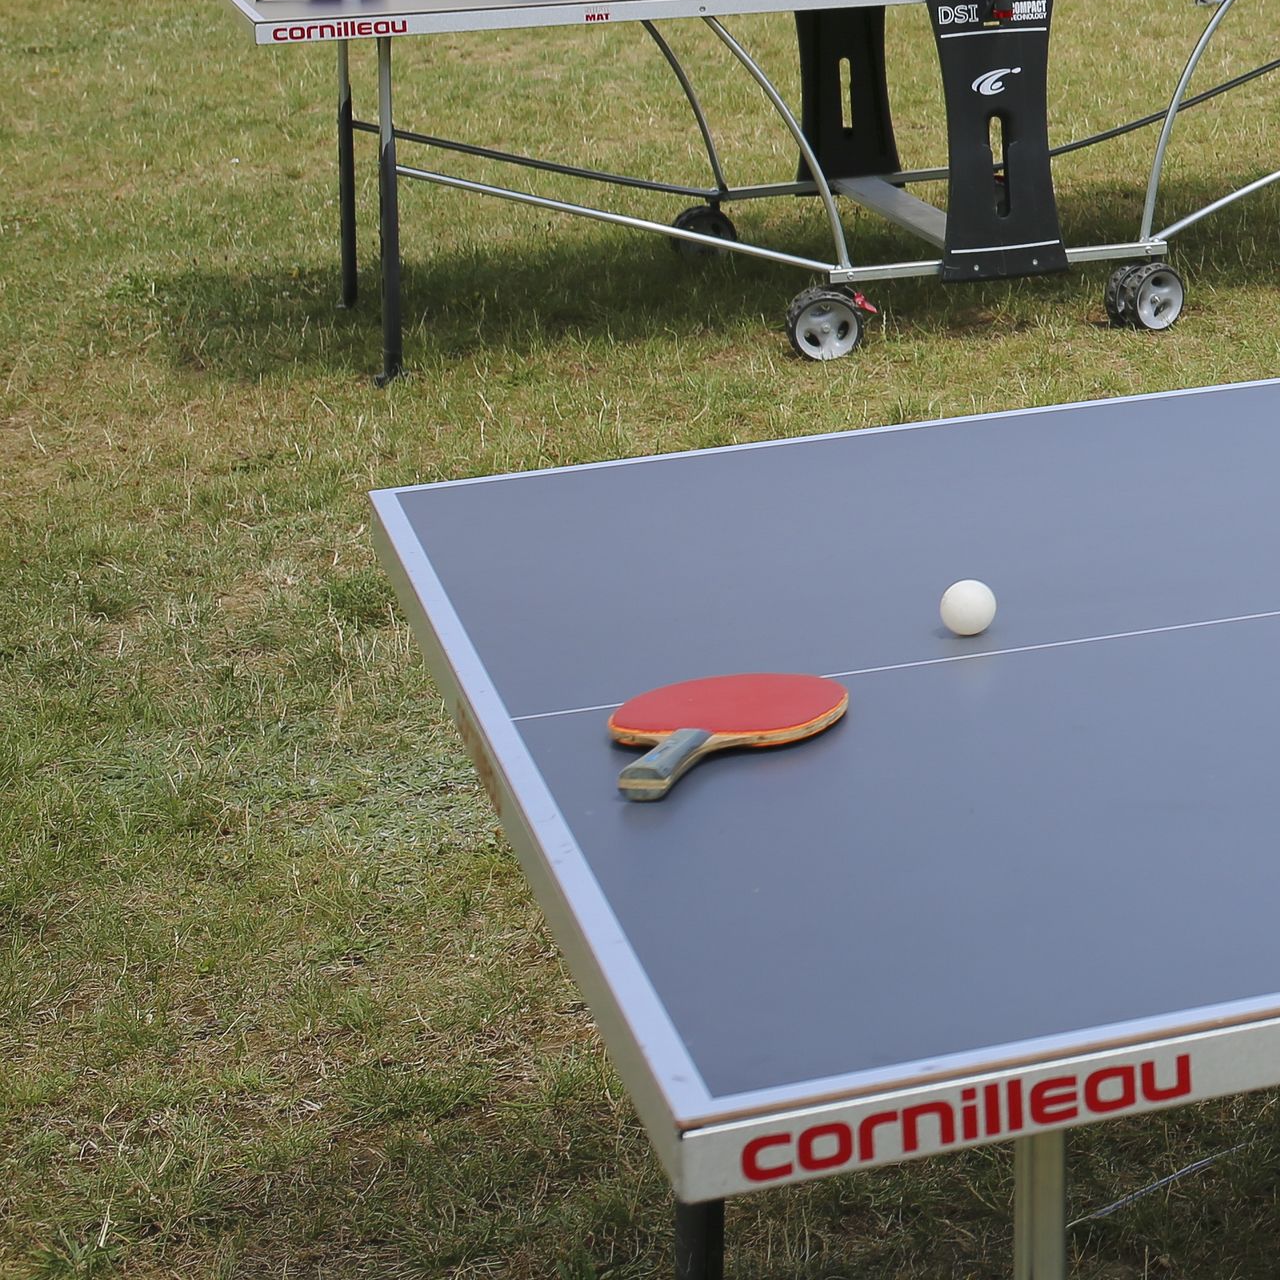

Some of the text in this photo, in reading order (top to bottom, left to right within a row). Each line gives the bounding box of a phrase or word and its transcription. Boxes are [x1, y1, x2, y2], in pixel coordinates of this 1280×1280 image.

[585, 13, 609, 22] MAT
[938, 4, 979, 25] DSI
[272, 20, 408, 41] cornilleau
[741, 1053, 1192, 1182] cornilleau
